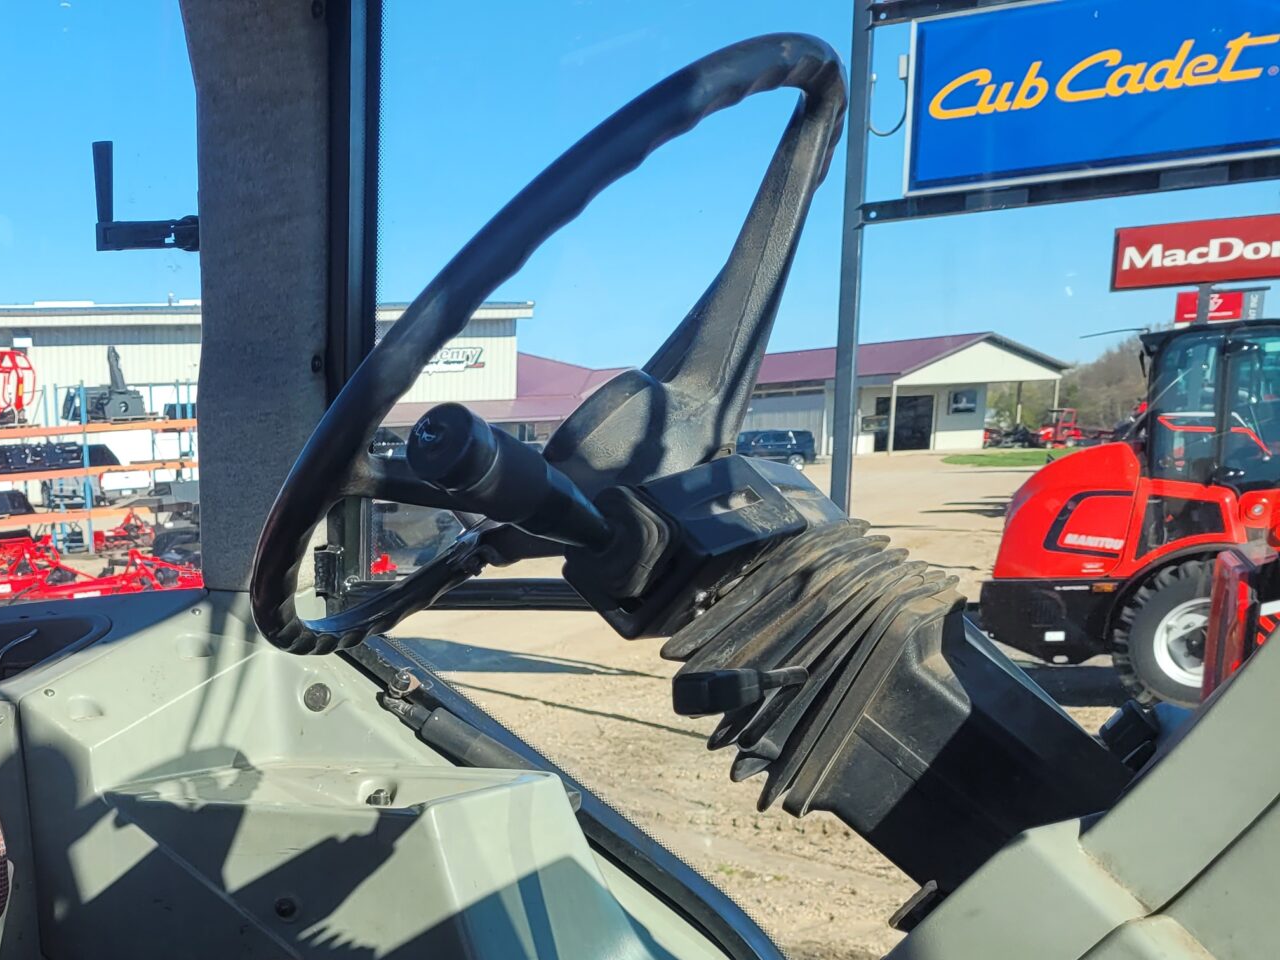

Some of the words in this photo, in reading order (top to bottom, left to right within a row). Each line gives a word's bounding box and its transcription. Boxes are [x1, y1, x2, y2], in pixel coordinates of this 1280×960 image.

[928, 60, 1049, 120] Cub
[1055, 32, 1280, 103] Cadet
[1063, 533, 1125, 550] MANITOU
